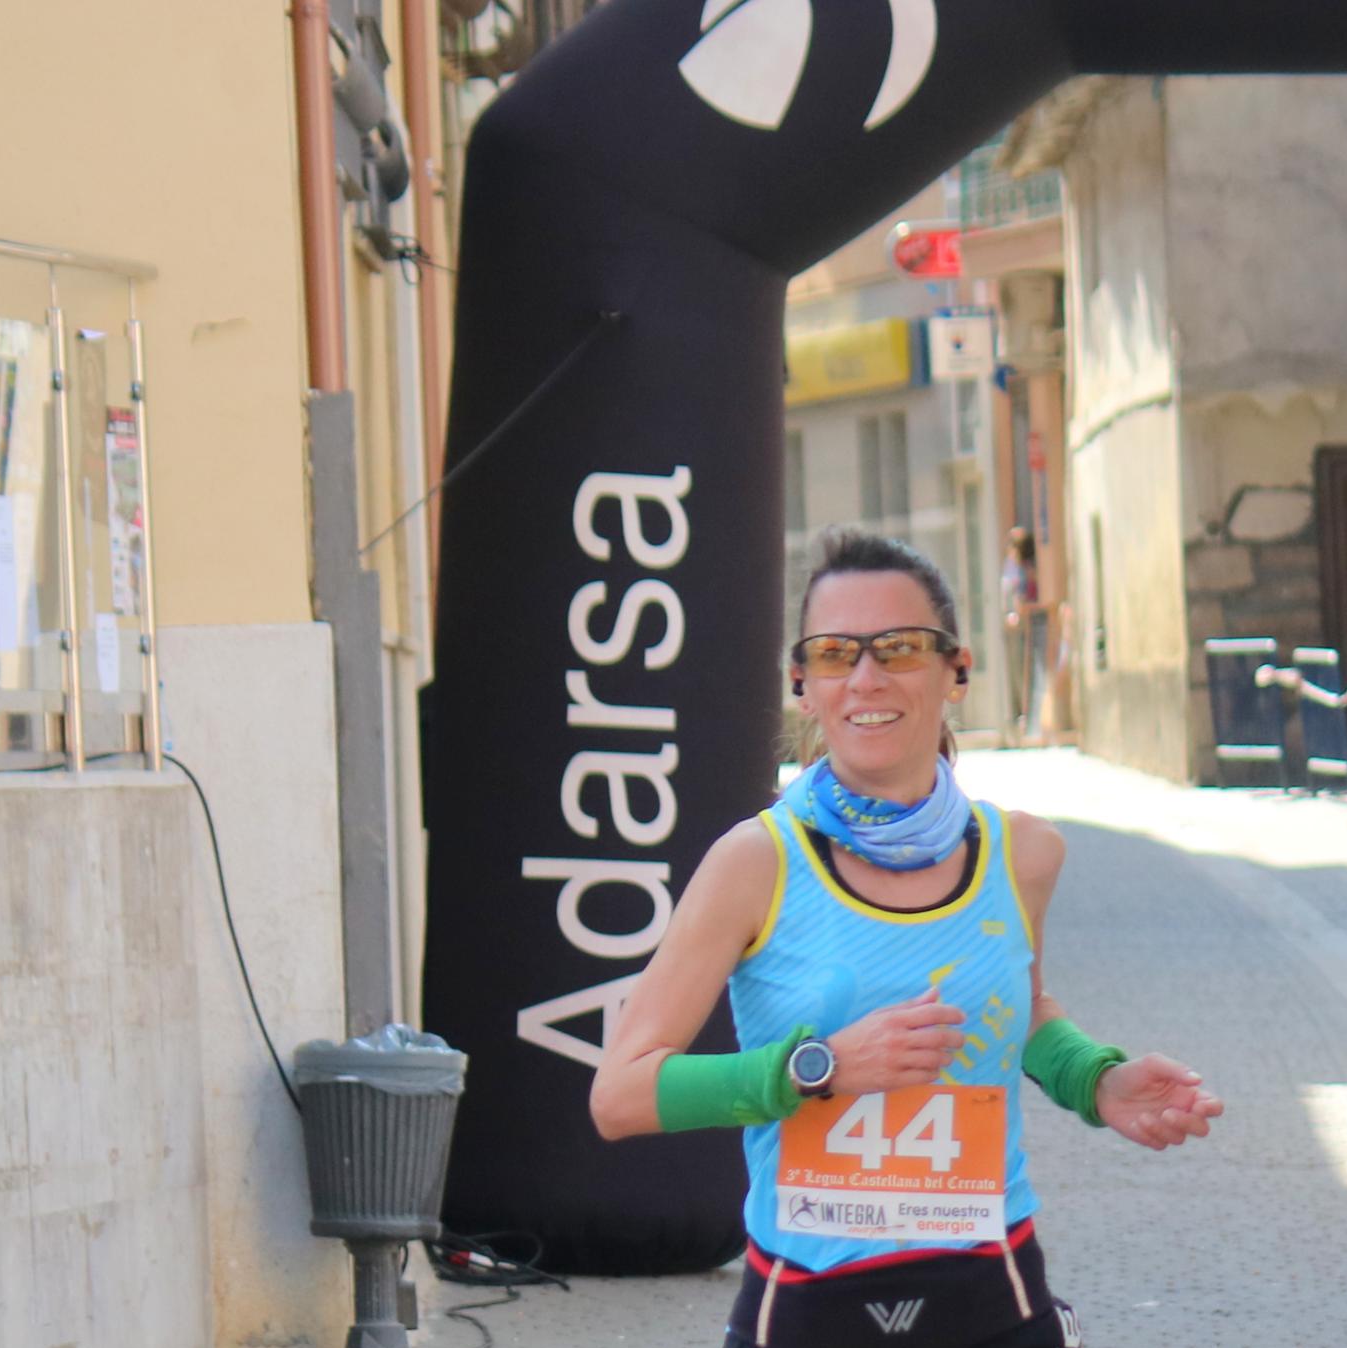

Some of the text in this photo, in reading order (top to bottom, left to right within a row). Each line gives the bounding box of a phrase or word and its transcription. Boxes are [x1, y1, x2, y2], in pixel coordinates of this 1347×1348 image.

[517, 465, 693, 1067] Adarsa
[825, 1091, 962, 1172] 44
[804, 1169, 845, 1187] Legua
[848, 1172, 921, 1189] Castellana
[924, 1175, 943, 1189] del
[947, 1175, 997, 1190] Cerrato
[820, 1202, 990, 1226] INTEGRA Eres nuestra
